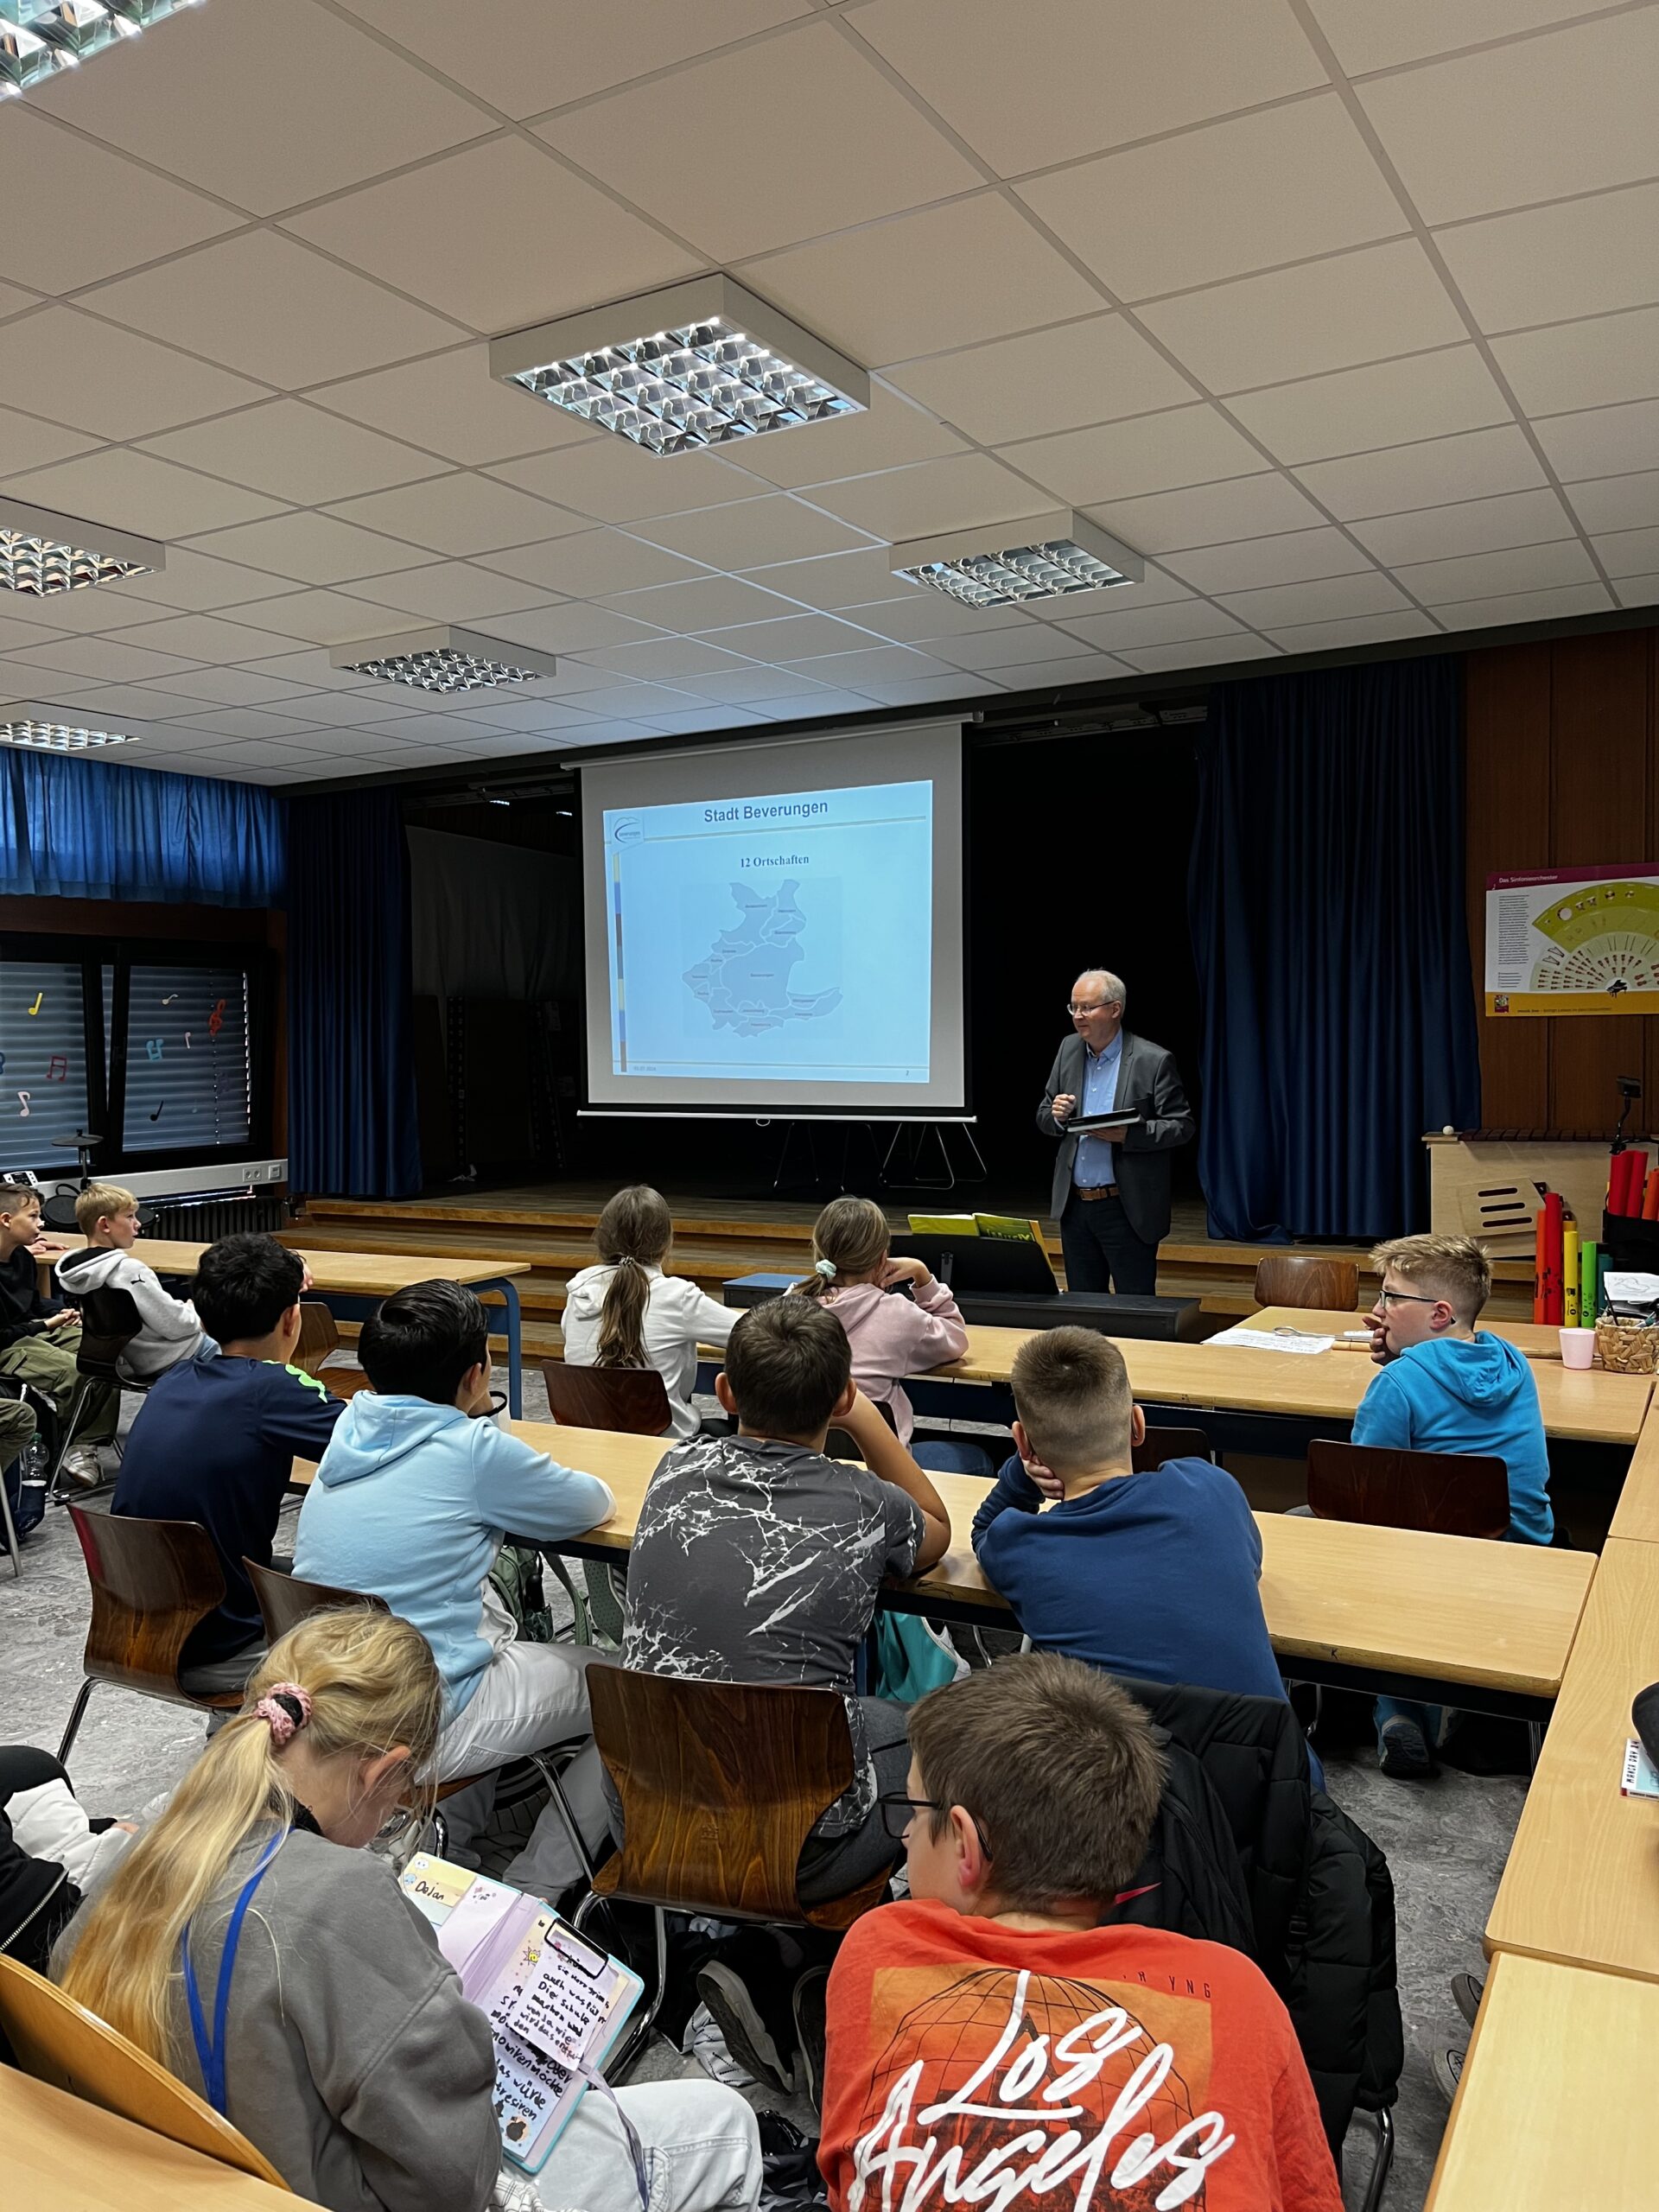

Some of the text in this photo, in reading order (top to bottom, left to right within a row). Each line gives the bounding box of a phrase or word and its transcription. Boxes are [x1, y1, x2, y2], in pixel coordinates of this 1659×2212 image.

[704, 802, 828, 822] Stadt Beverungen
[741, 855, 810, 868] 12 Ortschaften
[1169, 1975, 1211, 1998] YNG
[918, 1969, 1143, 2125] Los
[847, 2043, 1235, 2212] Angeles
